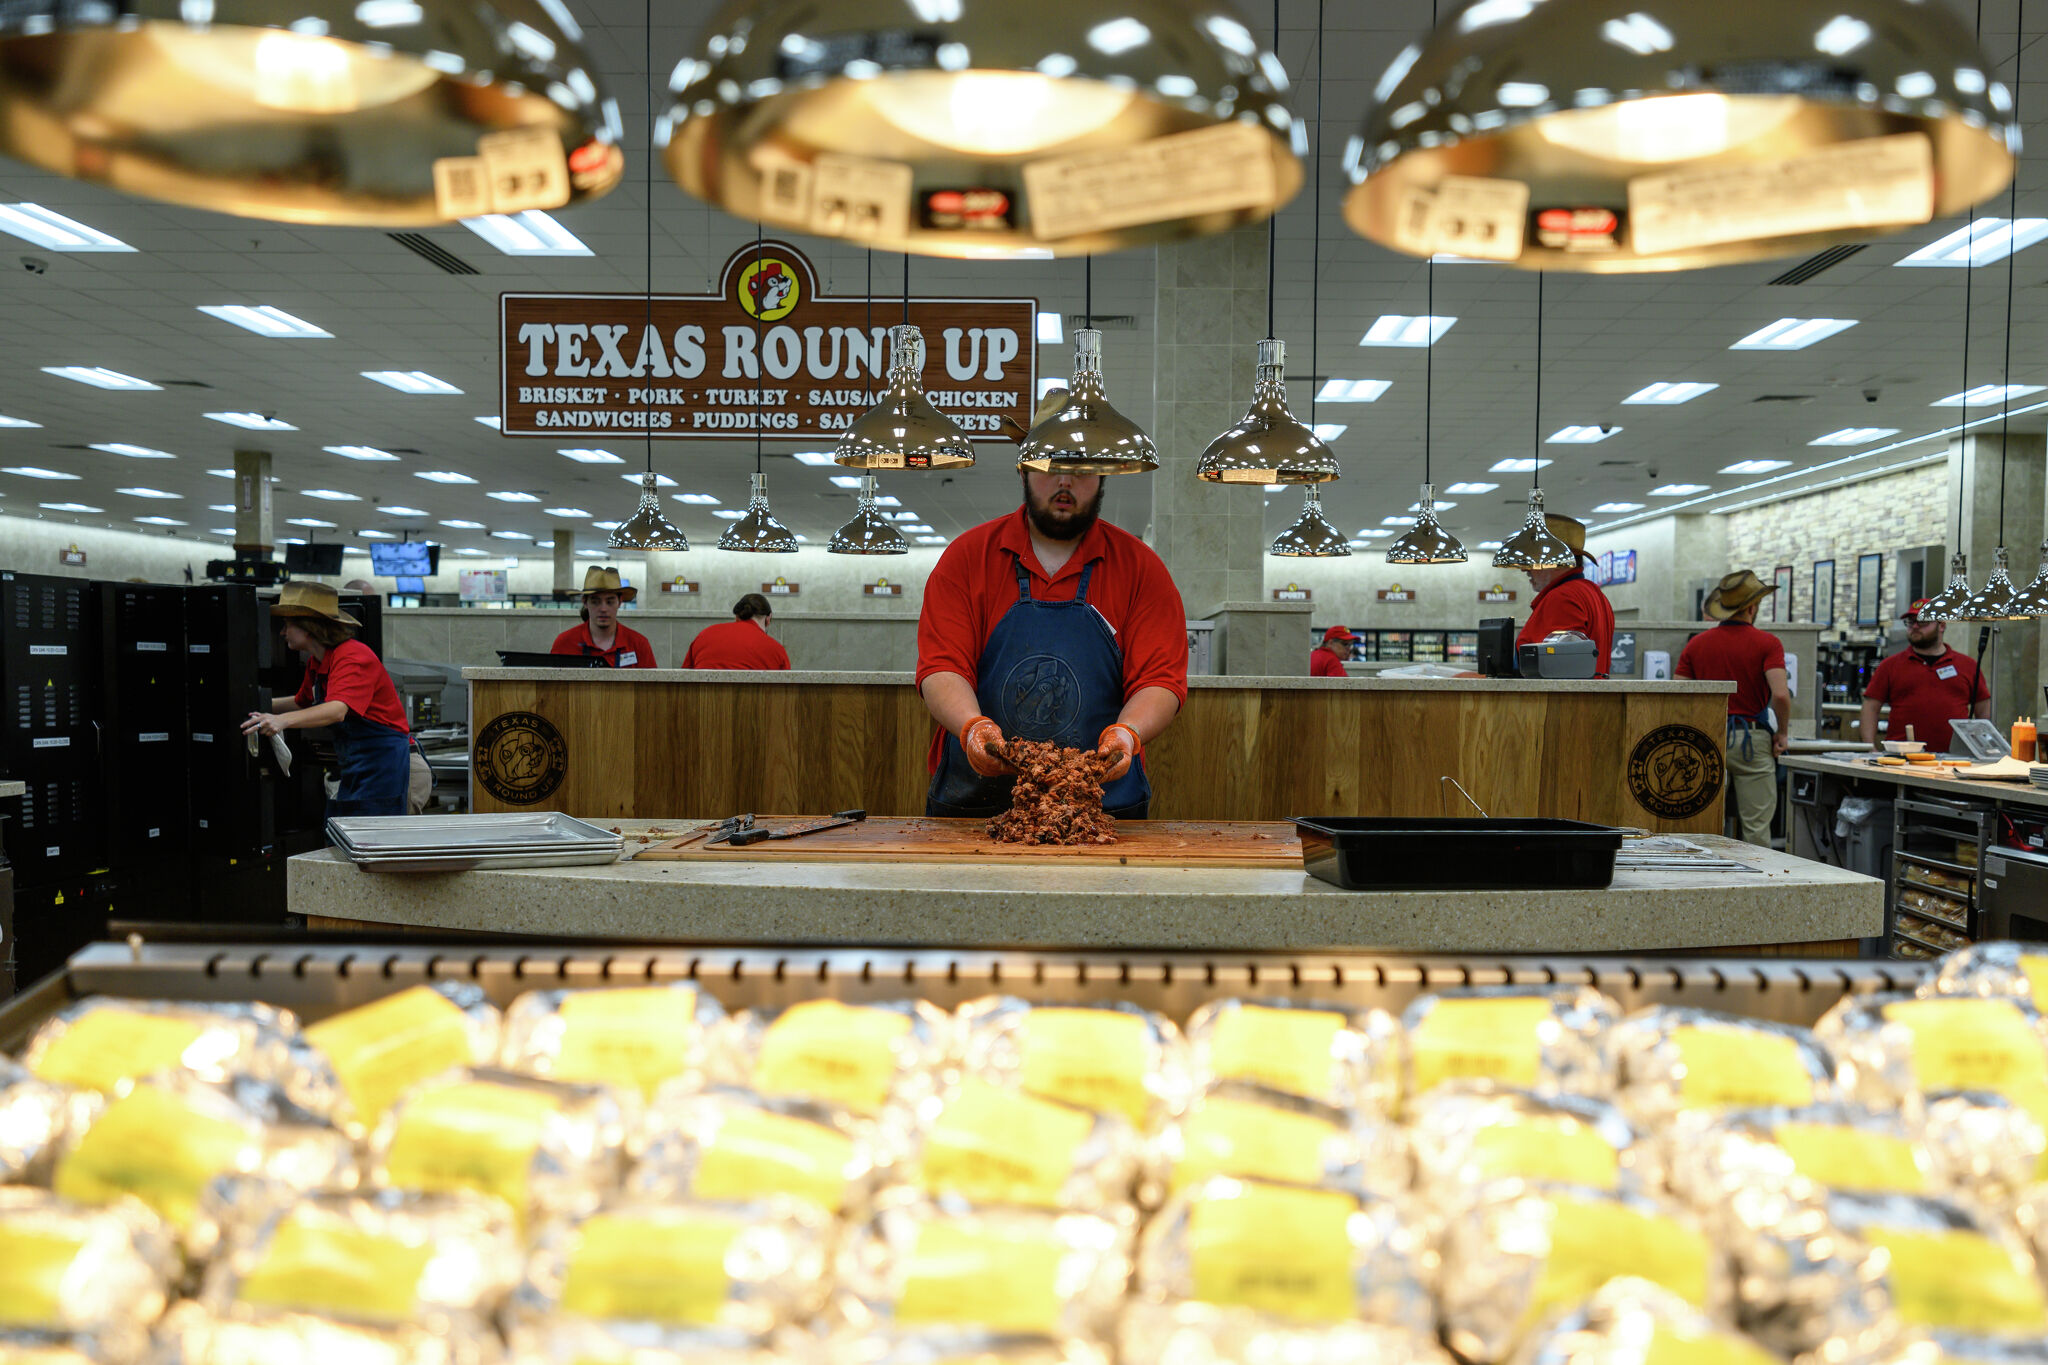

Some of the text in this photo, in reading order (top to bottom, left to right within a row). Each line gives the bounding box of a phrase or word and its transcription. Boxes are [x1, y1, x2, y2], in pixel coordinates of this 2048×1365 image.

[518, 323, 706, 379] TEXAS
[942, 328, 1019, 381] UP
[518, 387, 608, 404] BRISKET
[628, 388, 685, 405] PORK
[705, 389, 788, 406] TURKEY
[926, 390, 1019, 408] CHICKEN
[535, 411, 672, 428] SANDWICHES
[692, 412, 799, 429] PUDDINGS
[493, 717, 538, 731] TEXAS
[1647, 730, 1696, 744] TEXAS
[493, 783, 537, 800] ROUND
[1647, 796, 1692, 813] ROUND
